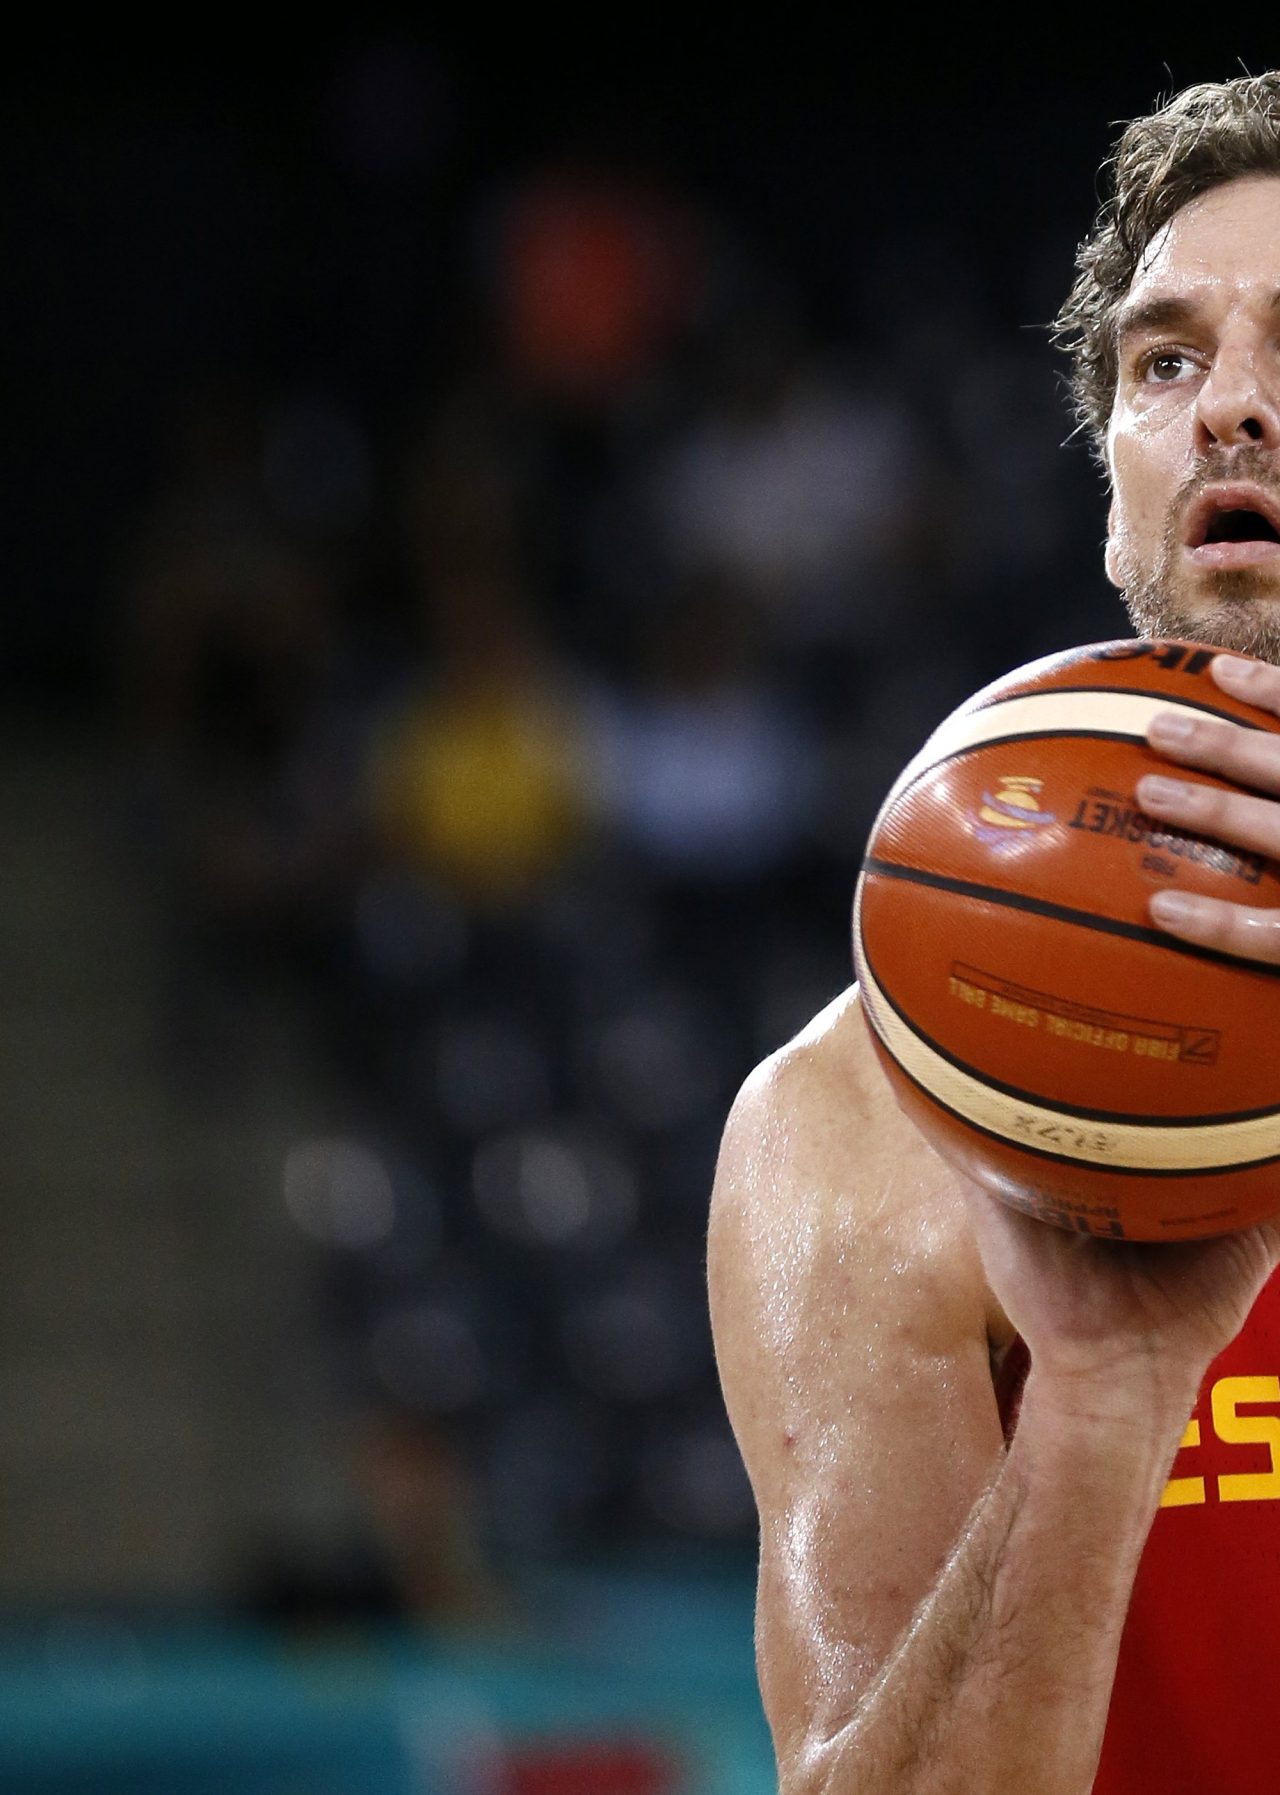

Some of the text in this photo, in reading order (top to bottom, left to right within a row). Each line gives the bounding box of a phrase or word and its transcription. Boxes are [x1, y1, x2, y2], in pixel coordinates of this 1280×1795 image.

[949, 976, 987, 1009] BALL
[1047, 1013, 1129, 1051] OFFICIAL
[1135, 1036, 1181, 1061] FIBA
